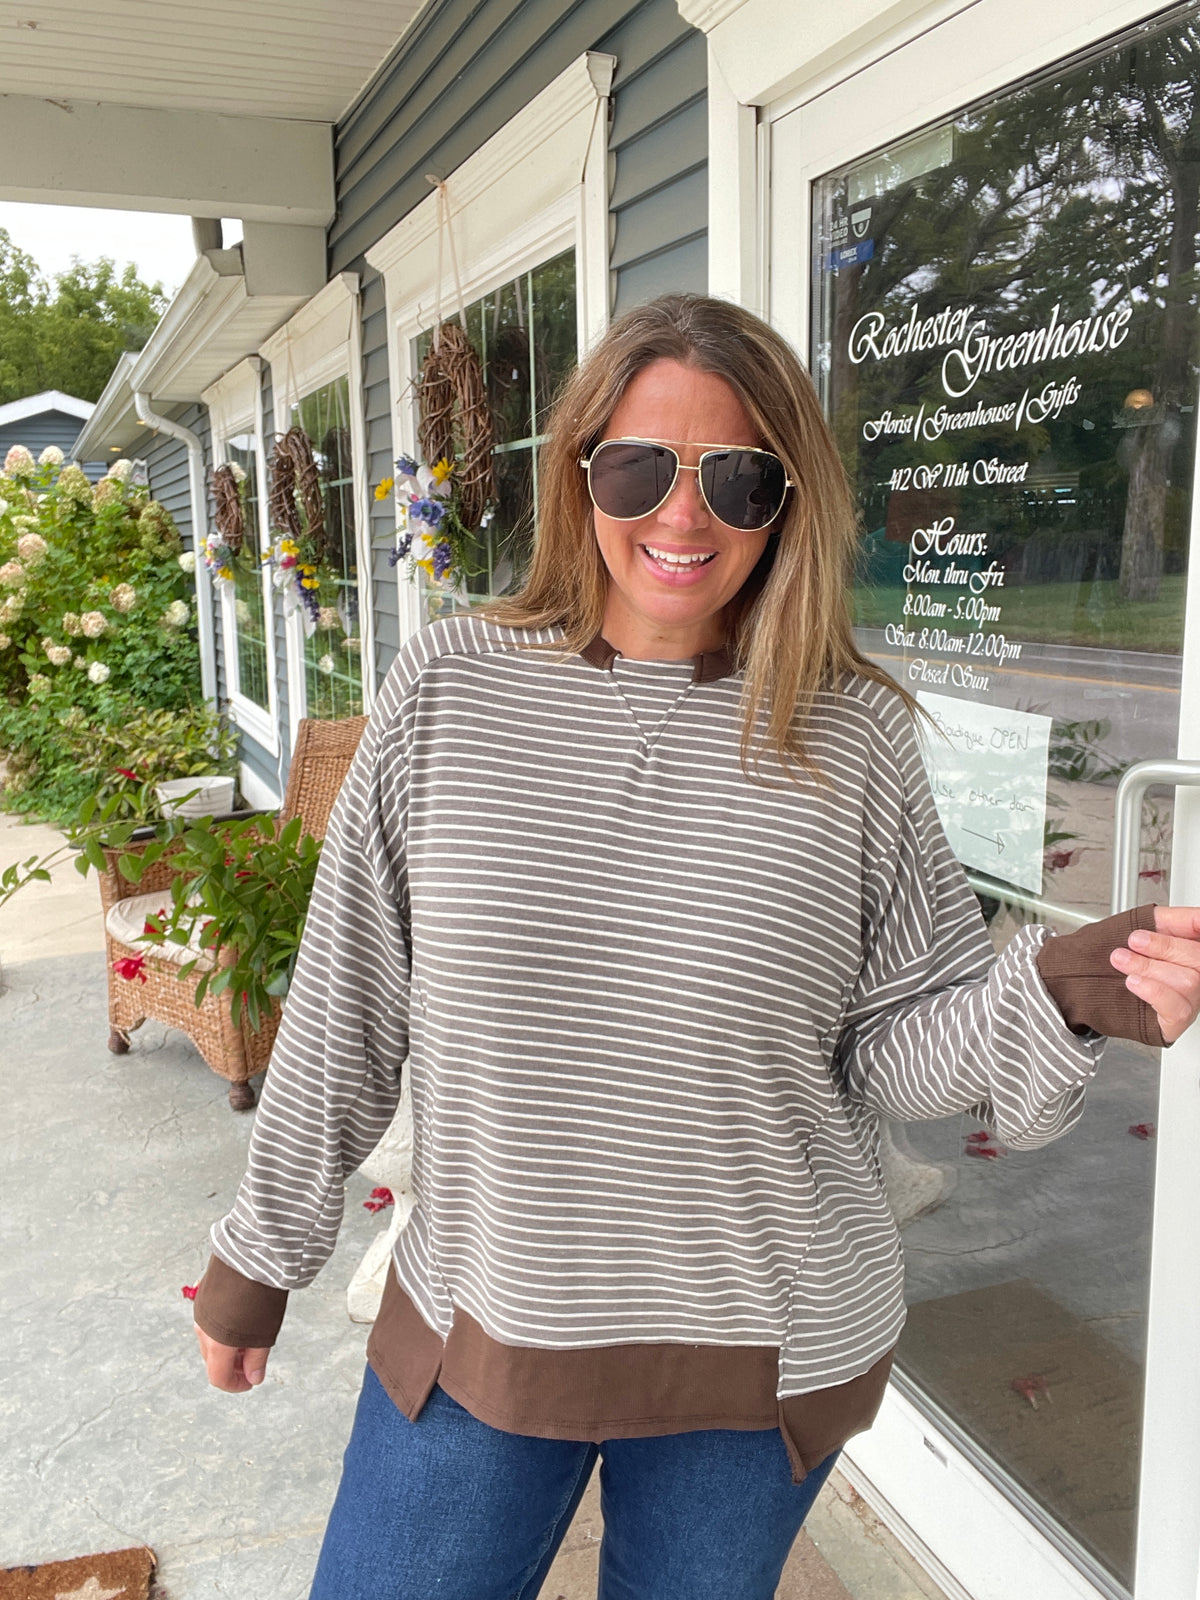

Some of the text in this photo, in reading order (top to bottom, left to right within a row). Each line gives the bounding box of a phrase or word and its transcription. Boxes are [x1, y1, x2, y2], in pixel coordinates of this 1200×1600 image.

[848, 303, 974, 363] Rochester
[942, 303, 1132, 398] Greenhouse
[889, 457, 1029, 491] 412 W. 11th Street
[911, 516, 989, 556] Hours:
[902, 560, 941, 583] Mon.
[943, 561, 969, 585] thru
[903, 593, 947, 618] 8:00am
[953, 596, 1002, 629] 5:00pm
[908, 658, 990, 692] Closed Sun.
[990, 726, 1030, 751] OPEN
